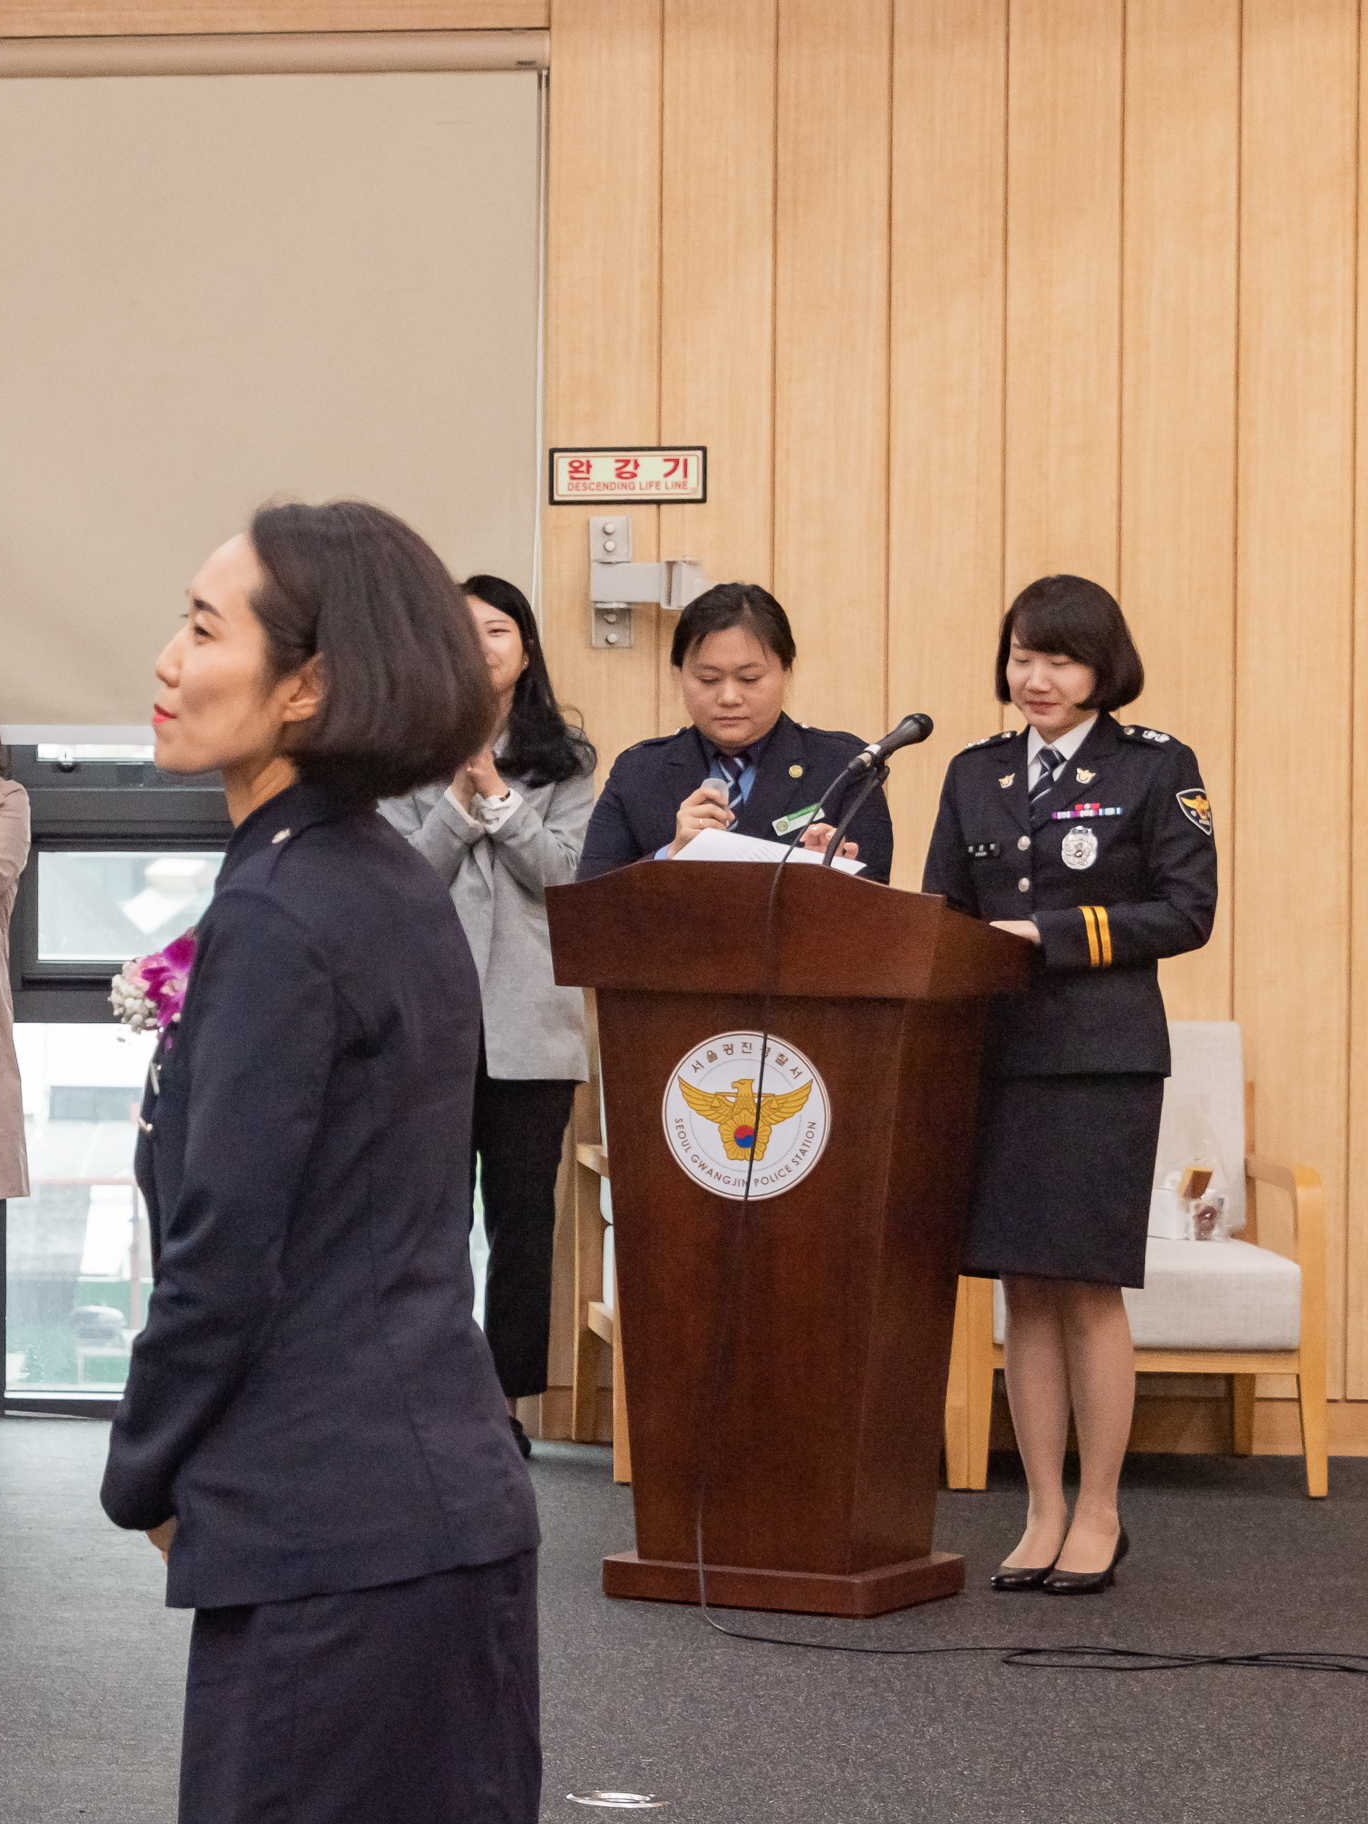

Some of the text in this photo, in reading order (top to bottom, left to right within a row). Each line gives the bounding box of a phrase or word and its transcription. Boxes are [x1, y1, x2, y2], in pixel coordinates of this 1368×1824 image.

[567, 480, 688, 492] DESCENDING LIFE LINE
[674, 1117, 817, 1188] SEOUL GWANGJIN POLICE STATION
